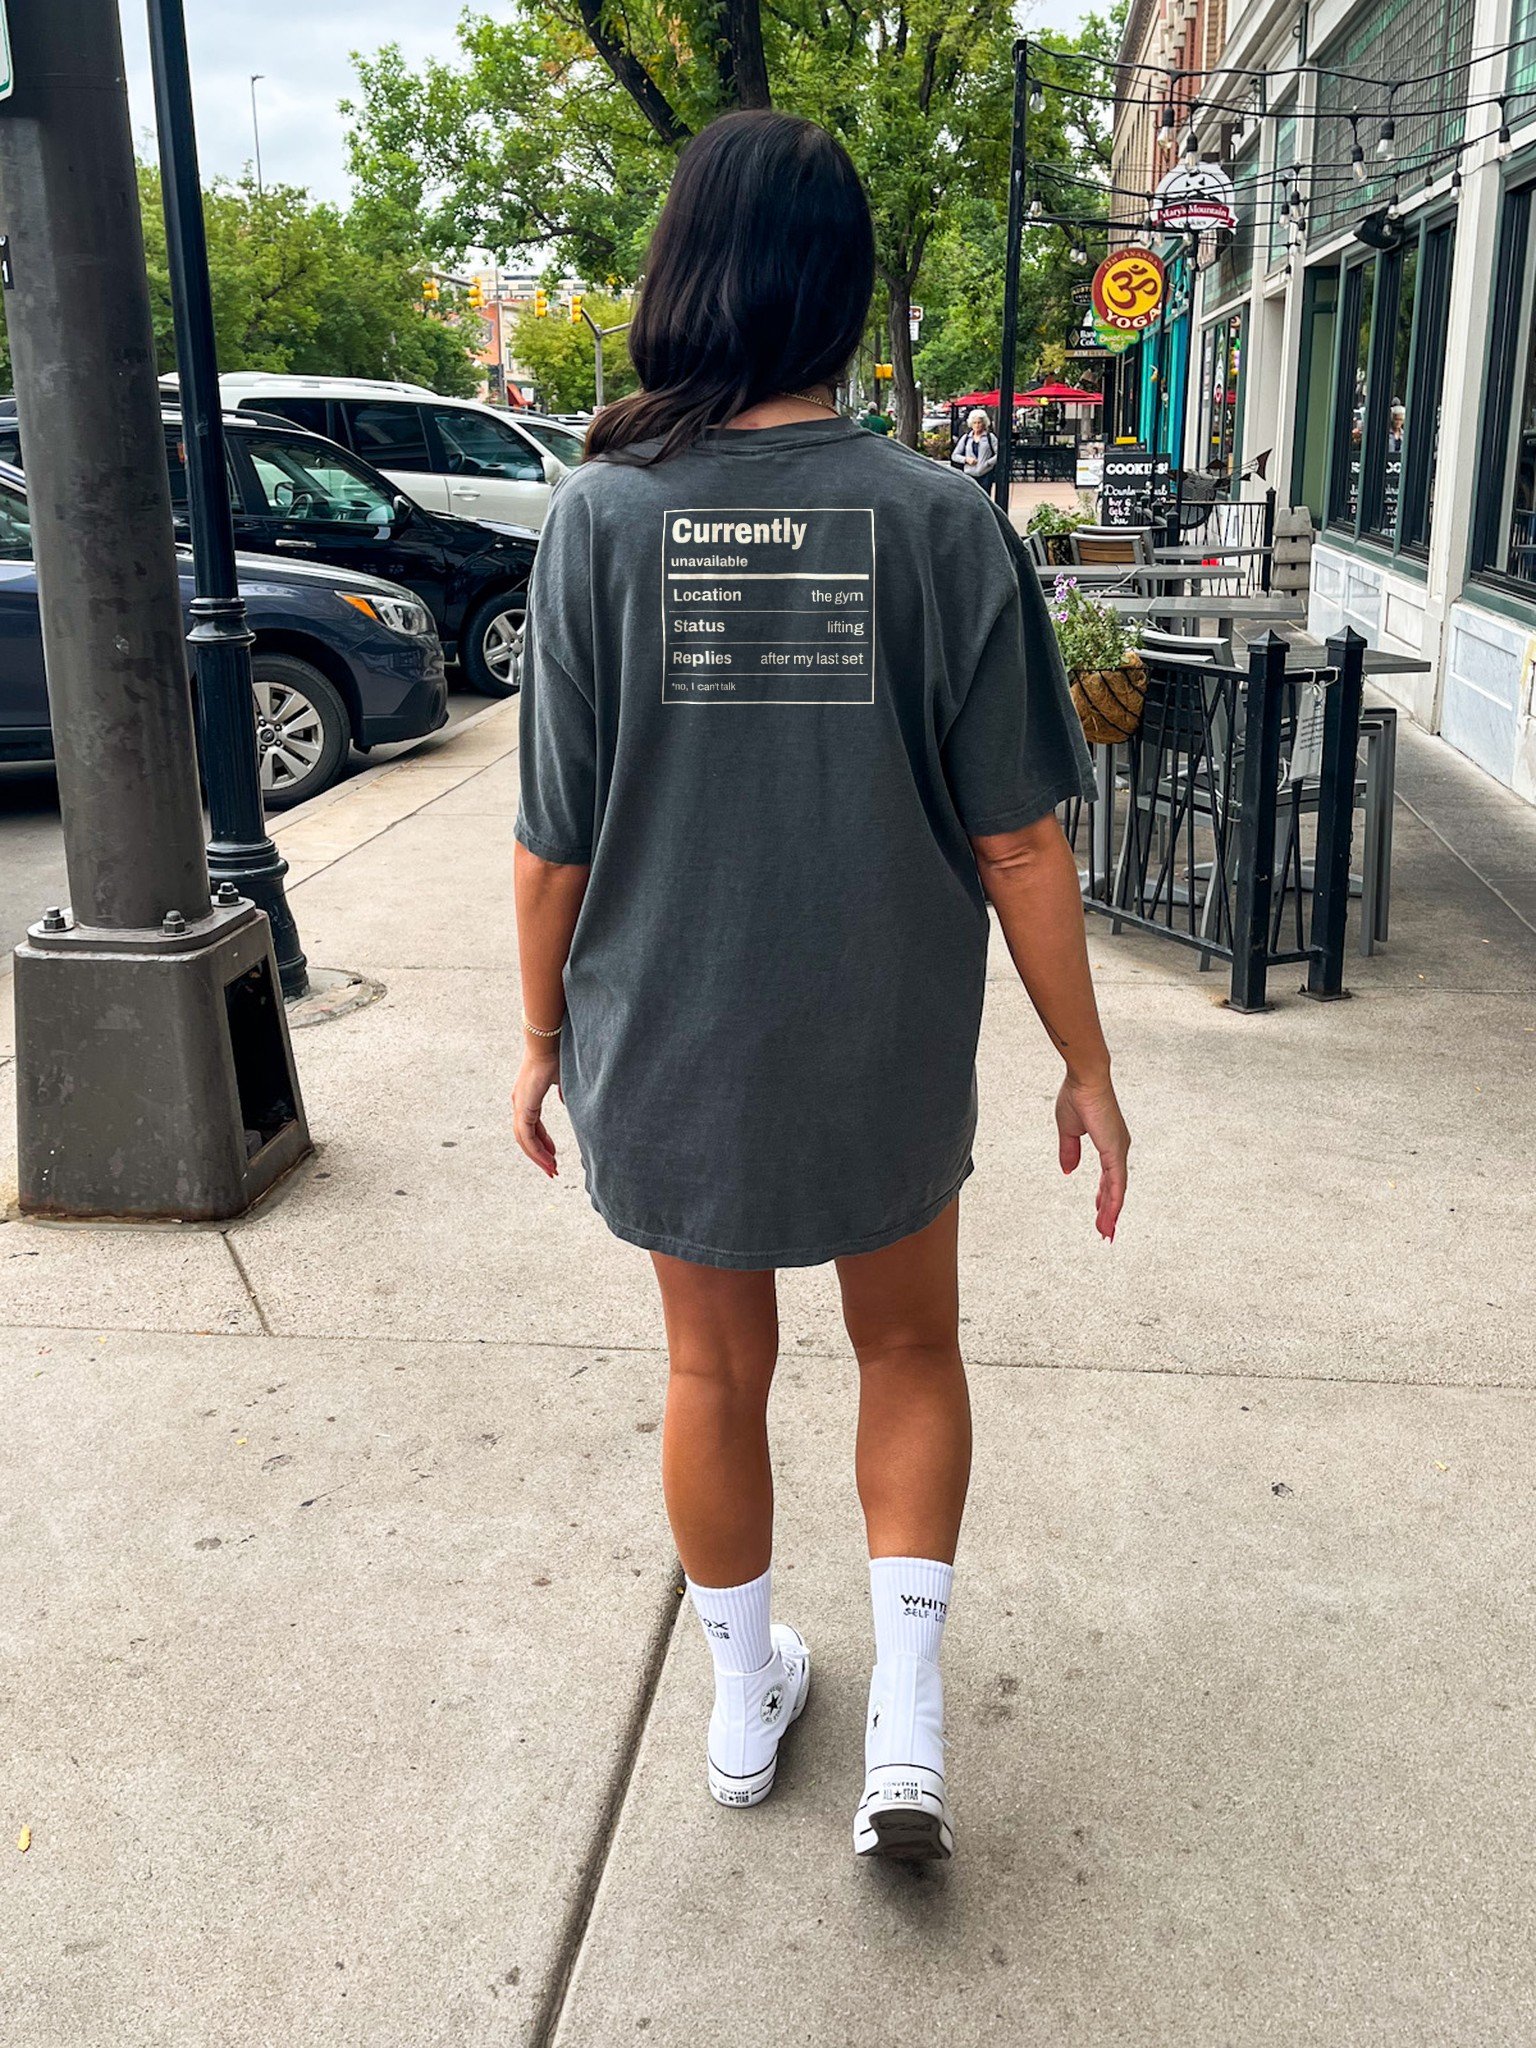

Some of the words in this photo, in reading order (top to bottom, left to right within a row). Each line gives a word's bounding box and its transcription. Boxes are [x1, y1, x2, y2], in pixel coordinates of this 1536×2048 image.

[1160, 205, 1187, 218] Mary's
[1188, 204, 1227, 216] Mountain
[1106, 302, 1162, 329] YOGA
[672, 517, 808, 550] Currently
[671, 555, 748, 567] unavailable
[673, 588, 742, 602] Location
[811, 590, 832, 602] the
[834, 591, 864, 605] gym
[673, 619, 725, 633] Status
[827, 621, 865, 636] lifting
[673, 651, 732, 667] Replies
[760, 652, 790, 665] after
[793, 655, 814, 667] my
[816, 652, 839, 665] last
[841, 652, 864, 665] set
[691, 682, 695, 691] I
[697, 682, 719, 691] can't
[720, 682, 736, 691] talk
[903, 1607, 930, 1618] SELF
[702, 1618, 729, 1630] OX
[903, 1788, 919, 1800] STAR
